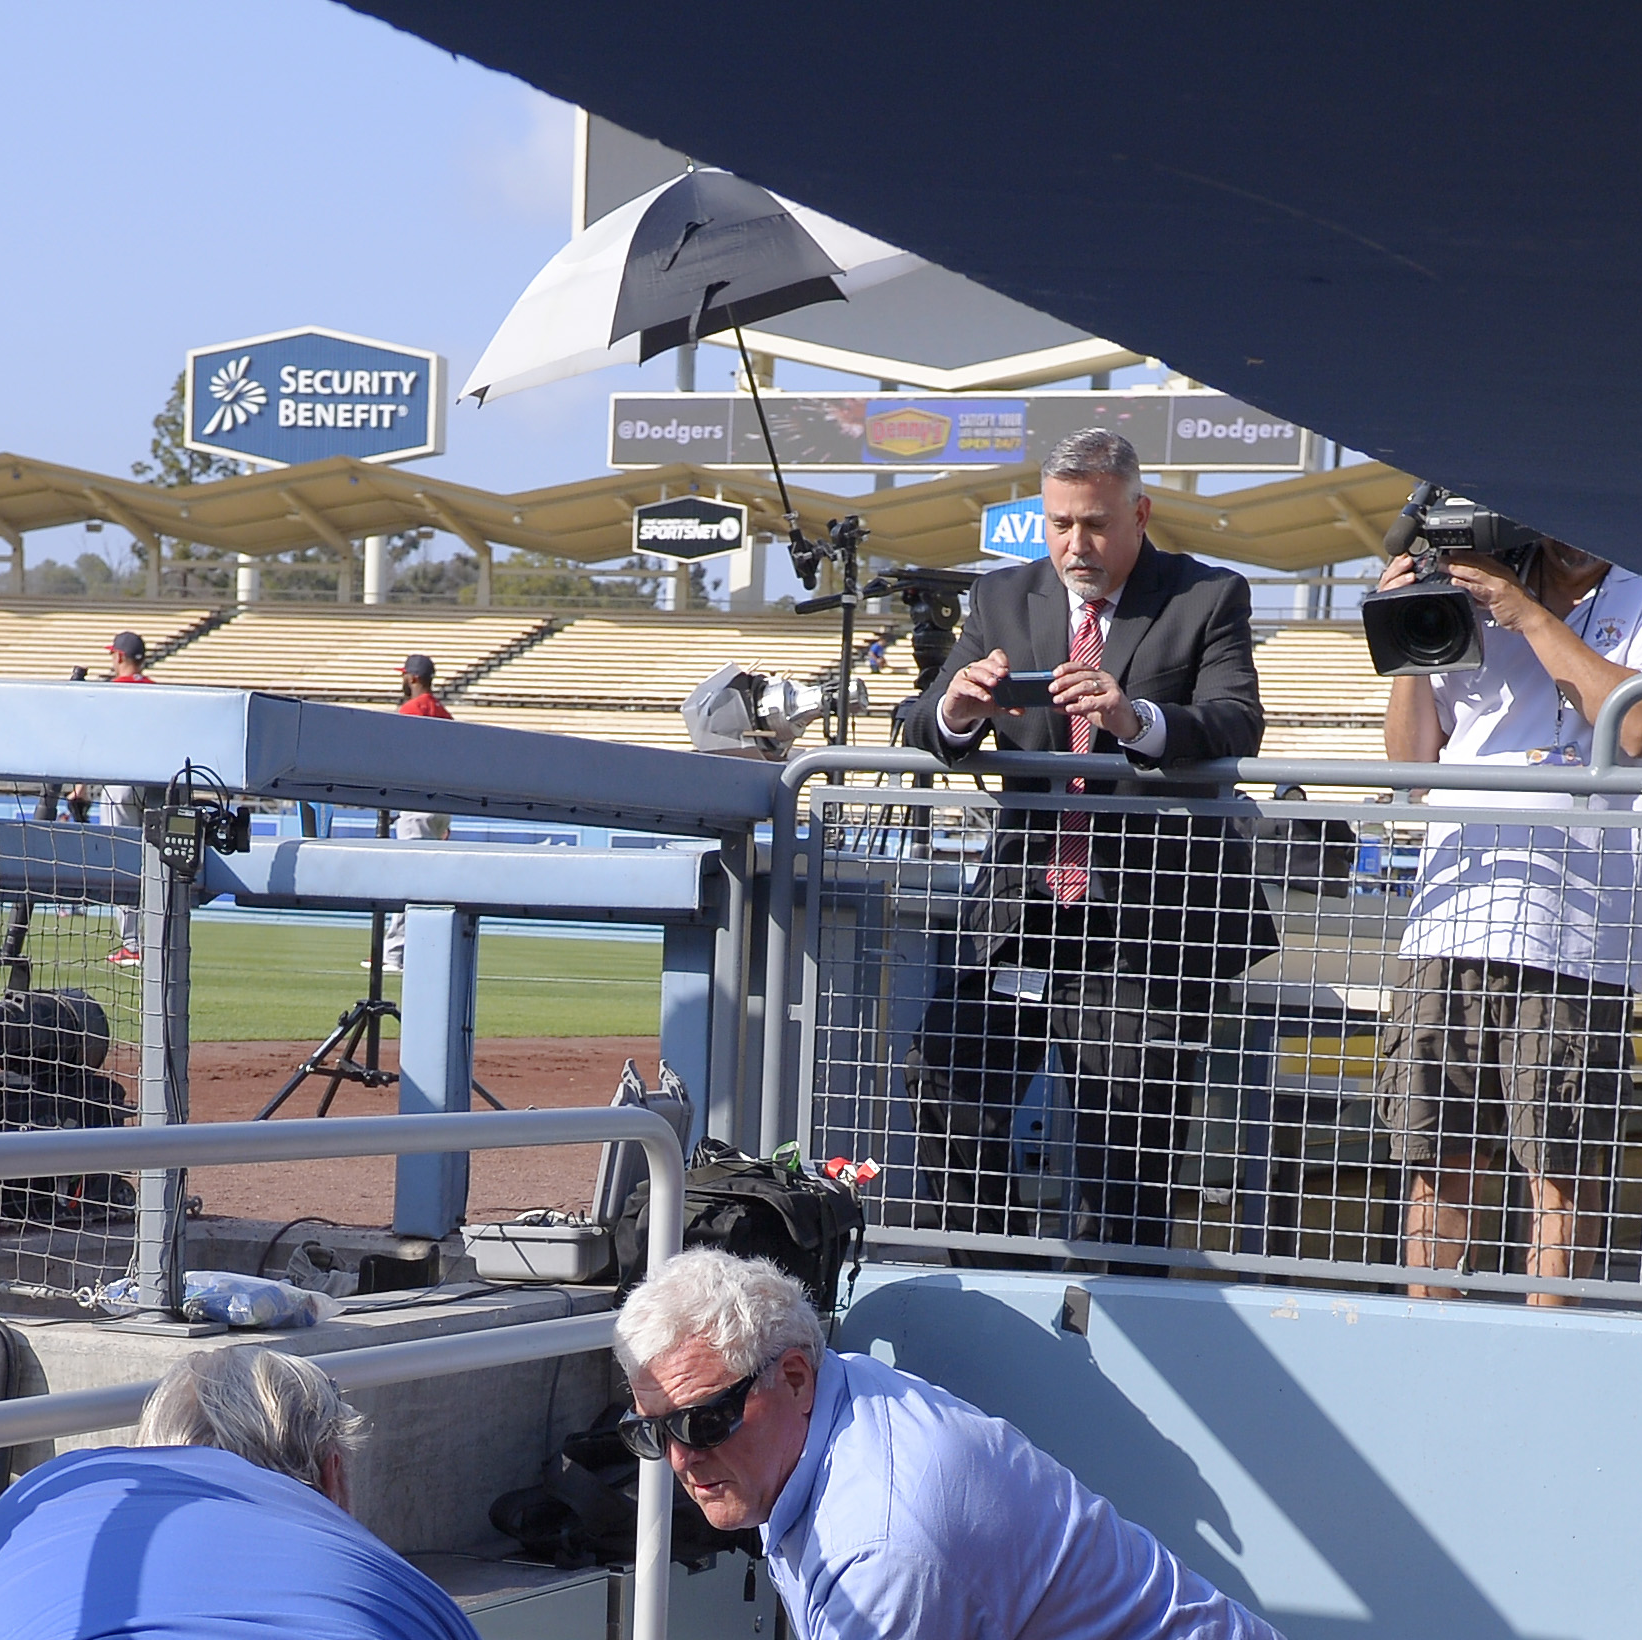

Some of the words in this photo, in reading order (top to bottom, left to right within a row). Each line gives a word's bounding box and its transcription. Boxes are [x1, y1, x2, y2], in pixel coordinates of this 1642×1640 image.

[279, 365, 417, 395] SECURITY
[617, 418, 724, 445] @Dodgers
[871, 418, 945, 447] Denny's
[958, 438, 991, 450] OPEN
[1176, 416, 1295, 444] @Dodgers
[639, 523, 720, 541] SPORTSNET
[990, 511, 1046, 544] AVI
